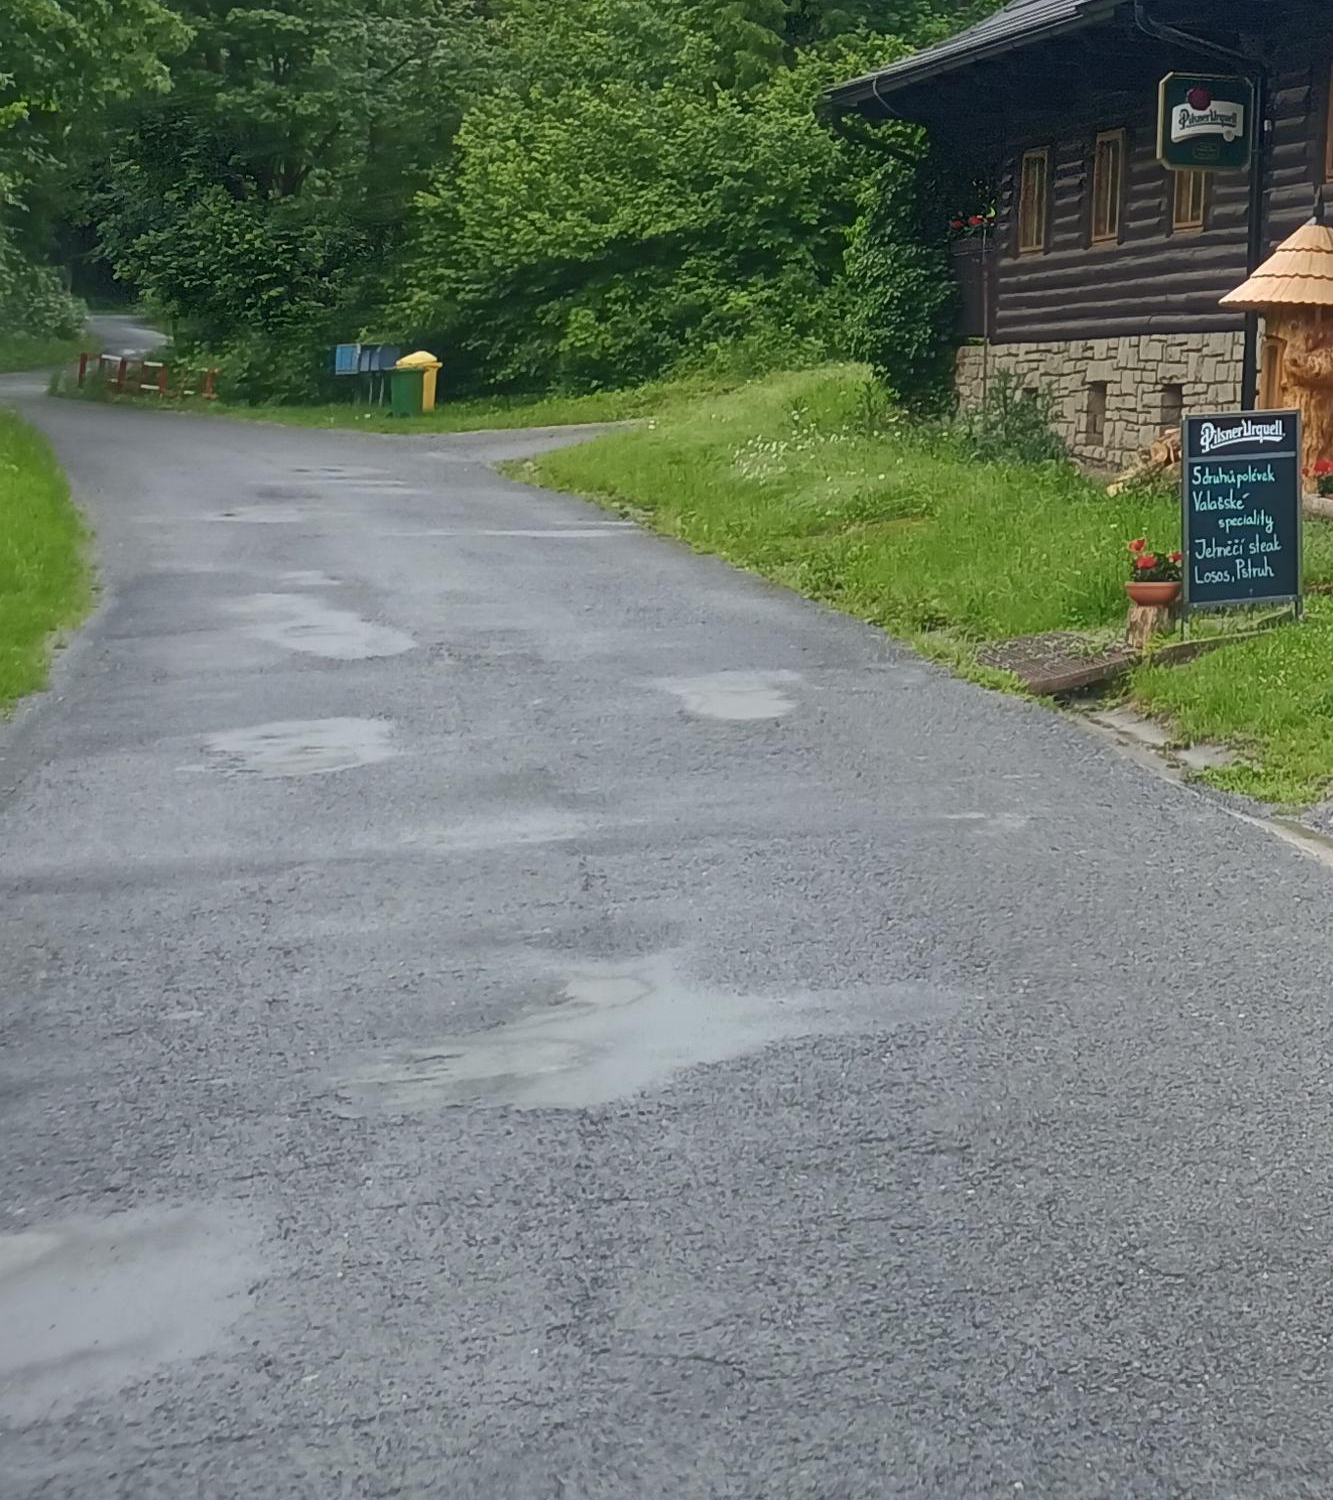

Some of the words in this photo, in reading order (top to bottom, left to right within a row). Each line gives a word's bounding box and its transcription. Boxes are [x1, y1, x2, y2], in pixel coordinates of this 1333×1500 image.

[1200, 422, 1244, 453] Pilsner
[1241, 418, 1283, 443] Urquell
[1236, 464, 1276, 489] polévek
[1192, 488, 1250, 511] Valašské
[1218, 509, 1274, 533] speciality
[1195, 537, 1245, 559] Jehněčí
[1249, 533, 1282, 554] steak
